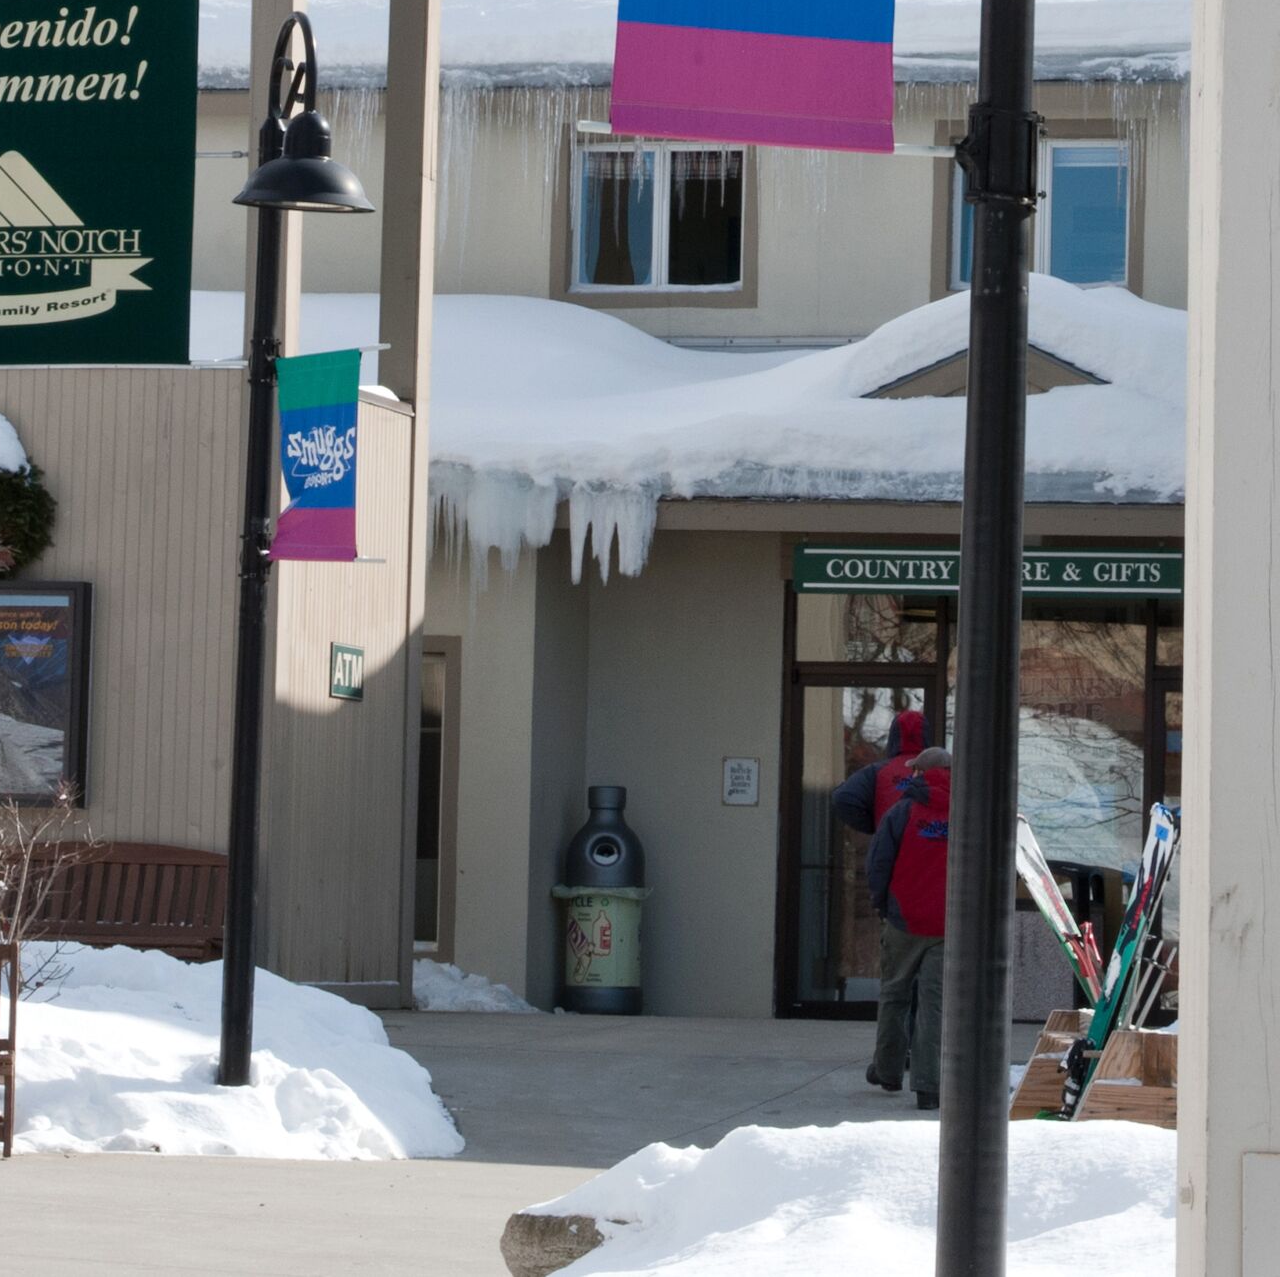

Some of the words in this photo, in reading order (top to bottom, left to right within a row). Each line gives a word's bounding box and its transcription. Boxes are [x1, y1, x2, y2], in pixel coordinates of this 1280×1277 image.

[40, 229, 142, 253] NOTCH
[47, 292, 107, 312] Resort
[287, 426, 356, 481] Smuggs
[826, 559, 955, 581] COUNTRY
[1062, 562, 1081, 582] &
[1093, 563, 1161, 582] GIFTS
[21, 620, 58, 631] today!
[334, 652, 362, 689] ATM
